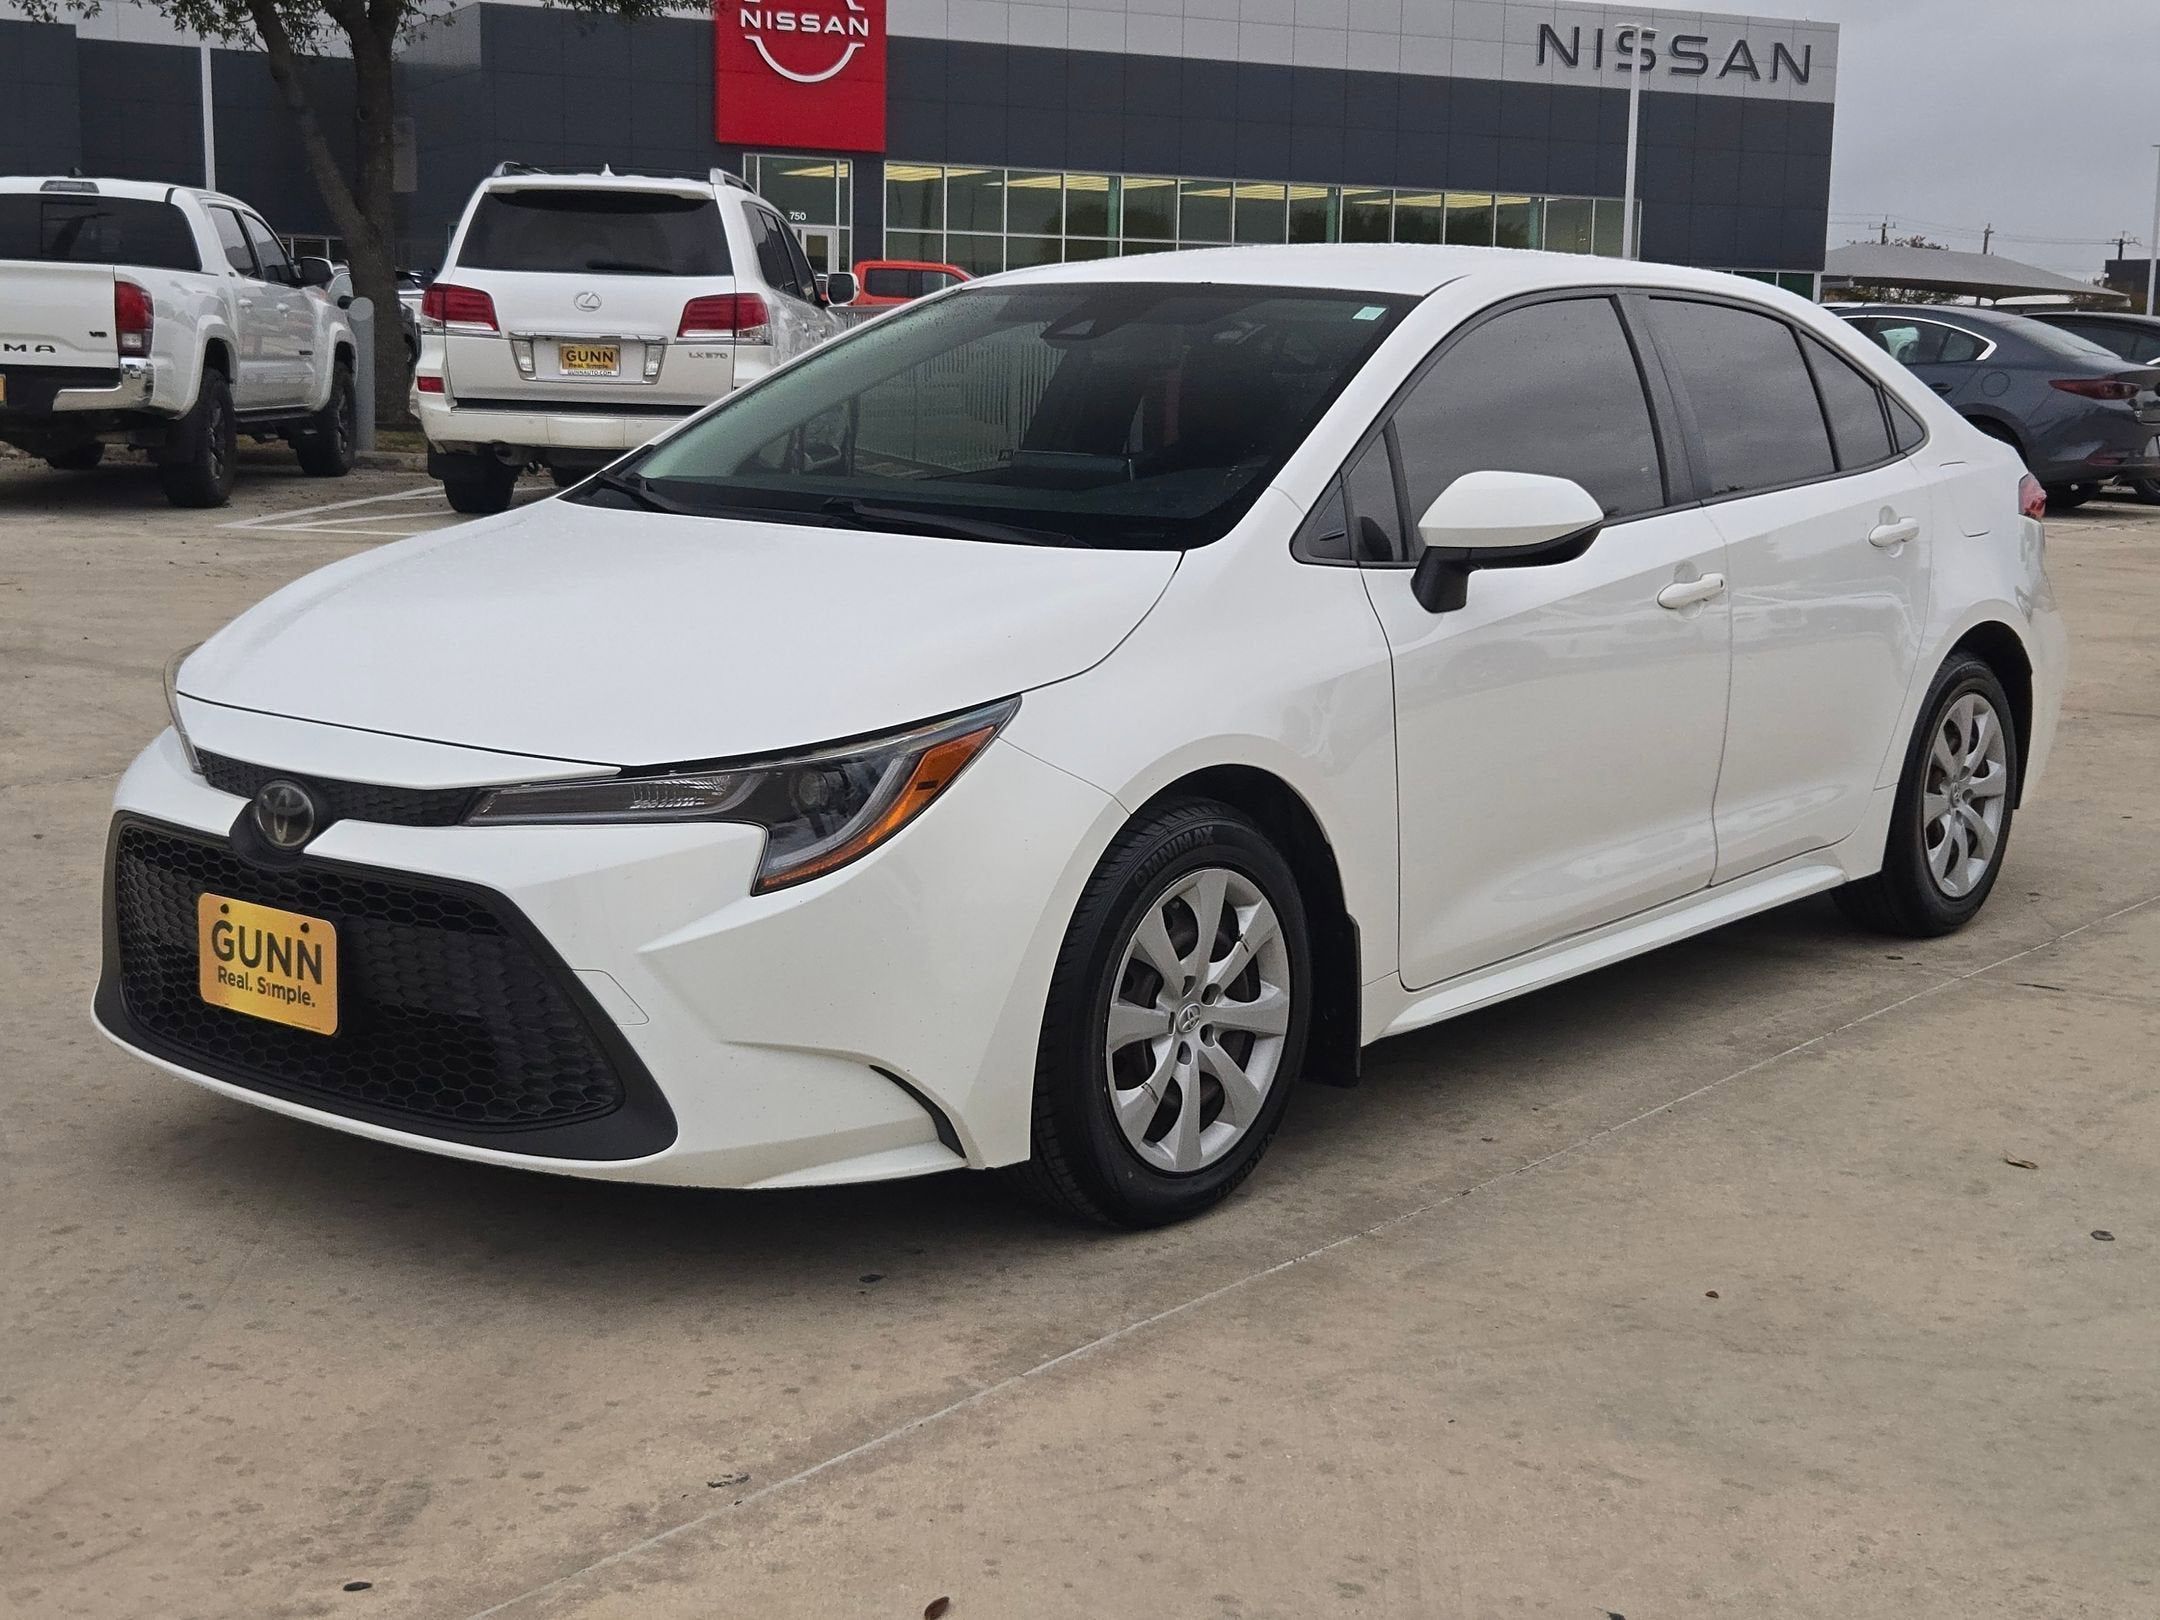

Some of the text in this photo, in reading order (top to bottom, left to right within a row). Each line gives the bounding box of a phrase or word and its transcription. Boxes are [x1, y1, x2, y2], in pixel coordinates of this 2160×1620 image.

[740, 8, 869, 37] NISSAN
[1536, 23, 1812, 85] NISSAN
[790, 211, 807, 221] 750
[566, 350, 613, 363] GUNN
[211, 919, 323, 986] GUNN
[217, 965, 253, 992] Real.
